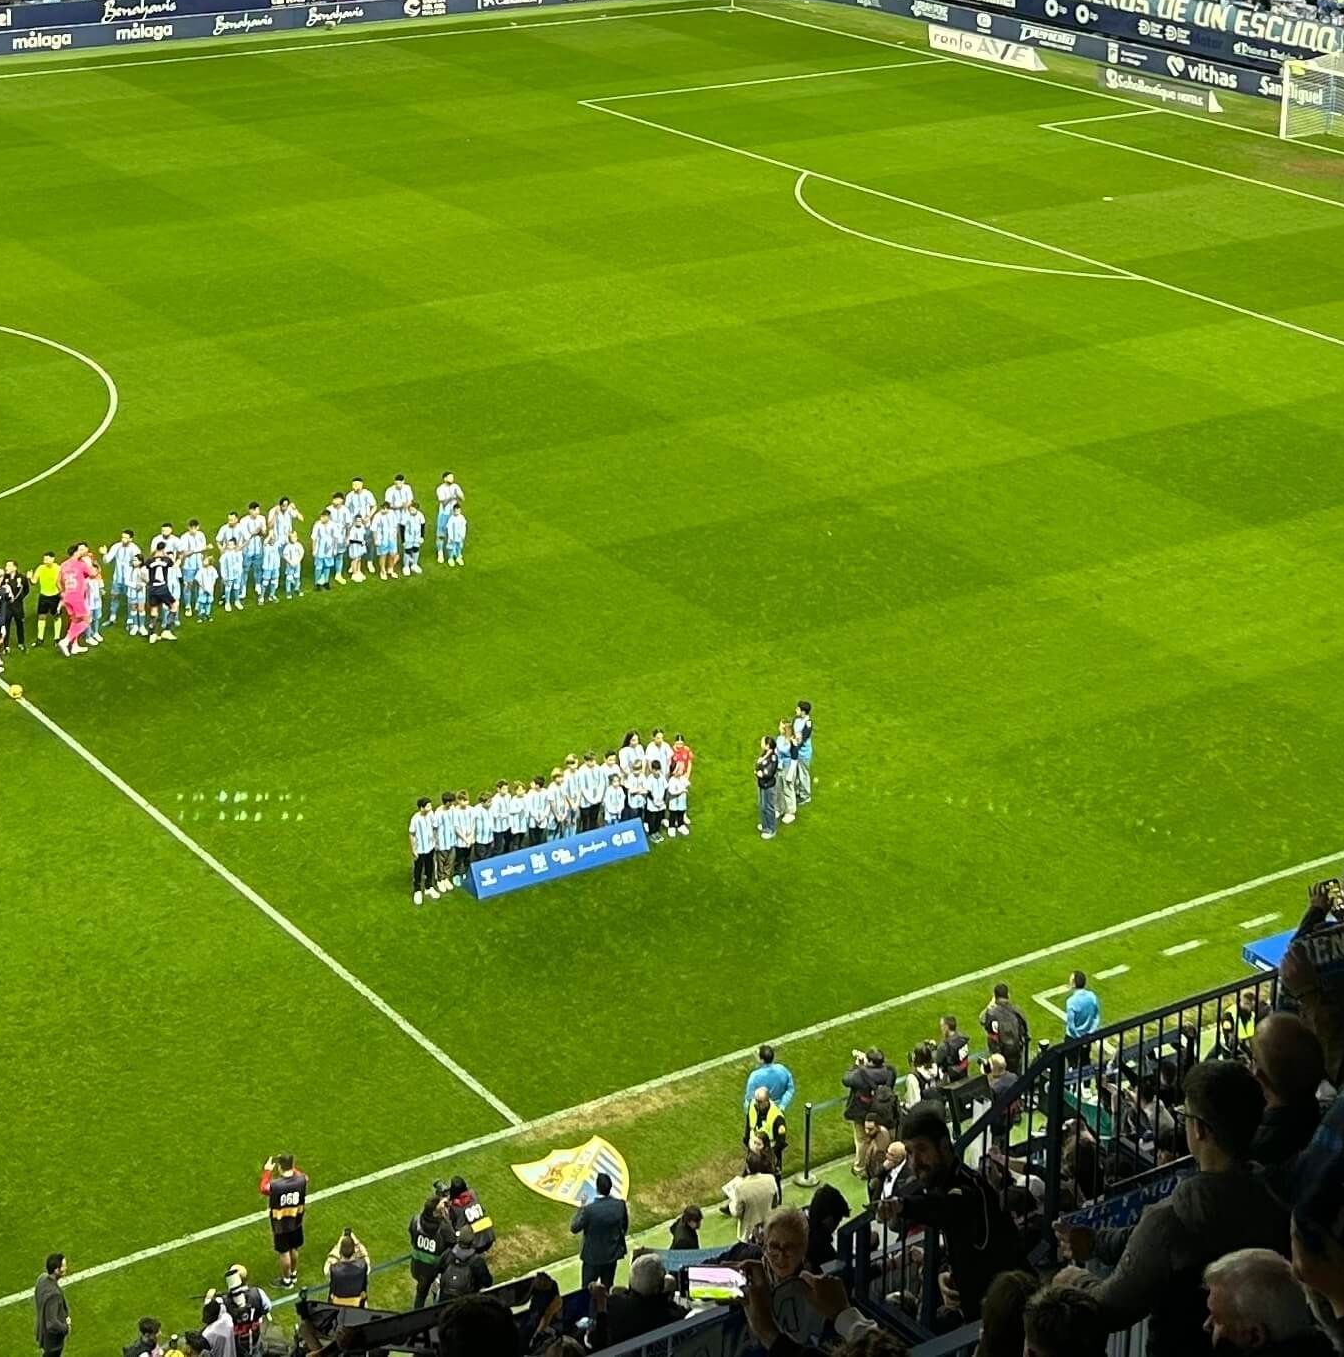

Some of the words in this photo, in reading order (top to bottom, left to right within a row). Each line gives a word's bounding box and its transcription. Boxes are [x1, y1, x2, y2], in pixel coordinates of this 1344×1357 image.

[1194, 2, 1231, 31] UN
[1234, 10, 1337, 53] ESCUDO
[1187, 63, 1238, 89] vithas
[417, 1234, 437, 1253] 009
